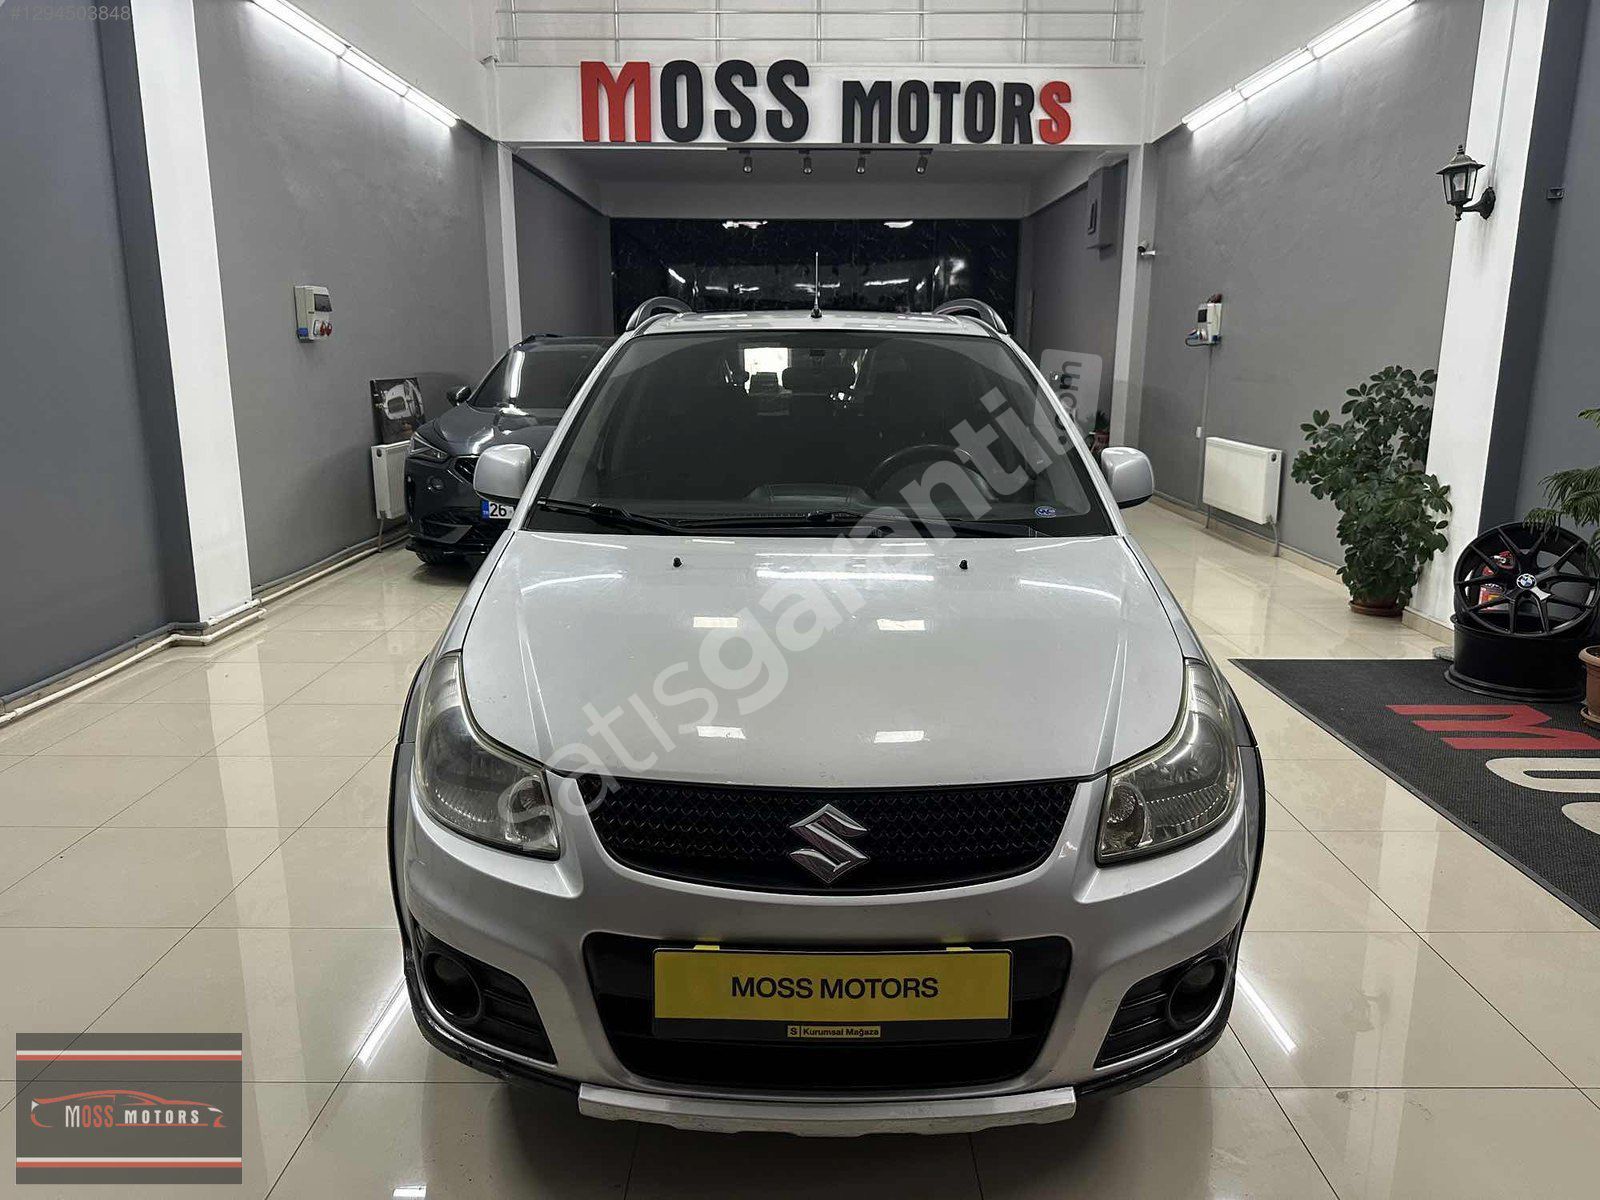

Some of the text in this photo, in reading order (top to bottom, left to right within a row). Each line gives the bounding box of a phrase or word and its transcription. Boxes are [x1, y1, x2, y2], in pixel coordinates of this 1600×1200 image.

[580, 59, 1072, 144] MOSS MOTORS
[731, 976, 939, 999] MOSS MOTORS
[803, 1027, 844, 1036] Kurumsal
[846, 1027, 879, 1037] Mağaza
